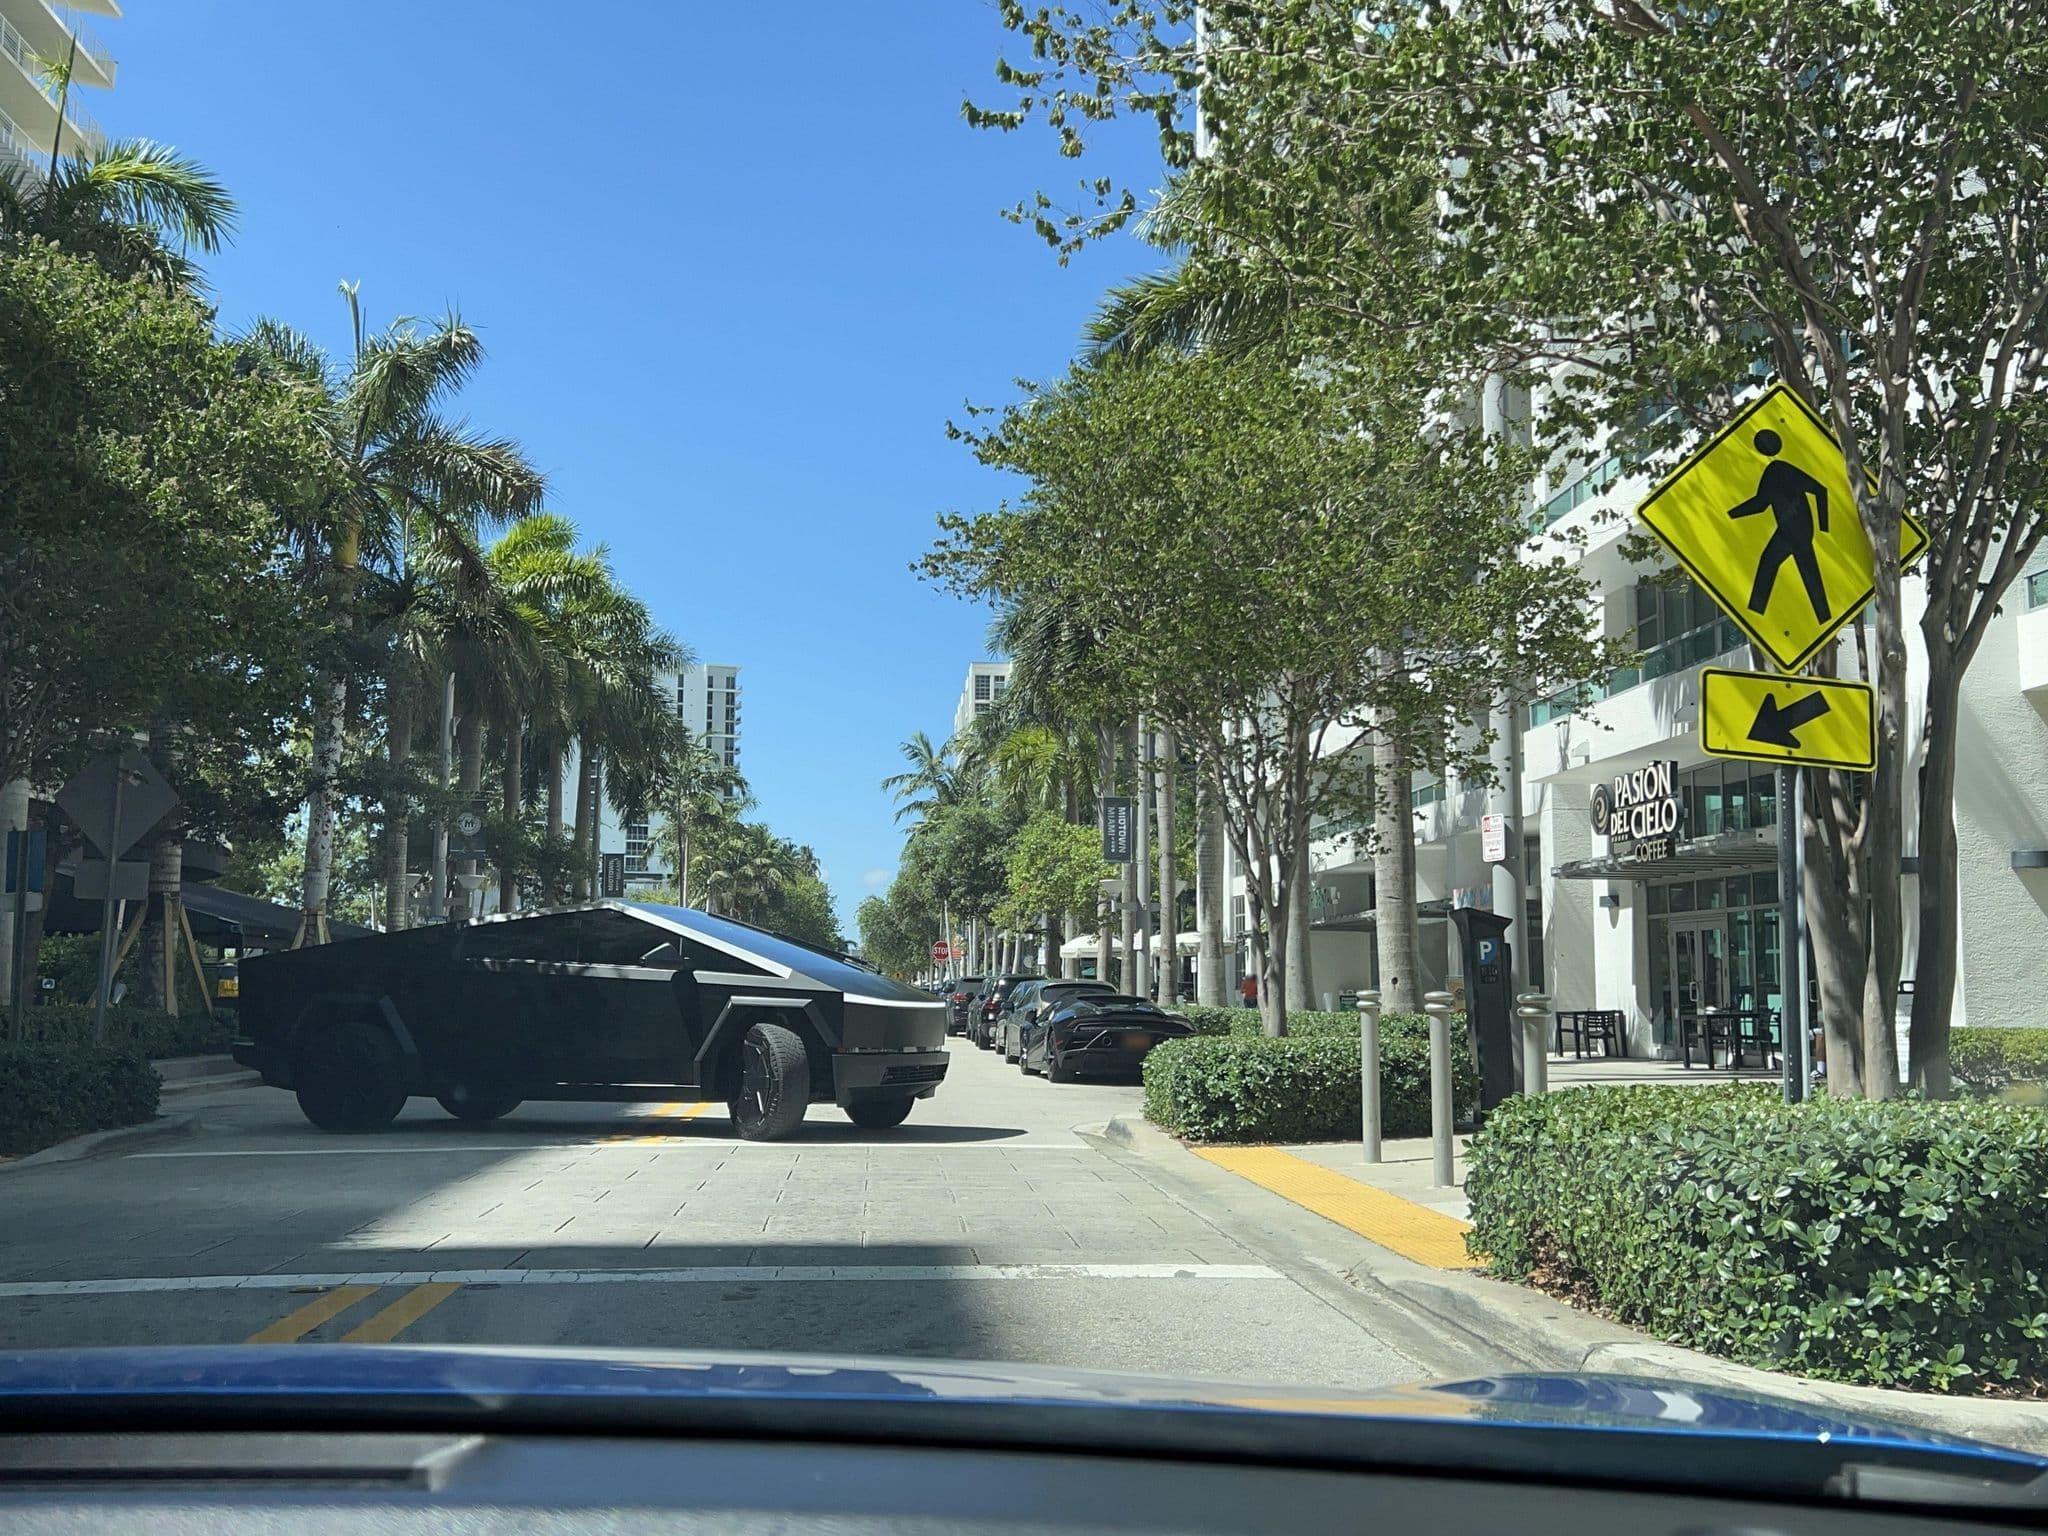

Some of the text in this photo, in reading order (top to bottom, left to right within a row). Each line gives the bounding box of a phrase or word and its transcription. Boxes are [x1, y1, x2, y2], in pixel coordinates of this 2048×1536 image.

[1615, 761, 1671, 808] PASIÓN
[1107, 806, 1115, 836] MIAMI
[1118, 806, 1127, 853] MIDTOWN
[1610, 798, 1677, 839] DEL CIELO
[1634, 838, 1668, 863] COFFEE
[1479, 941, 1492, 961] P
